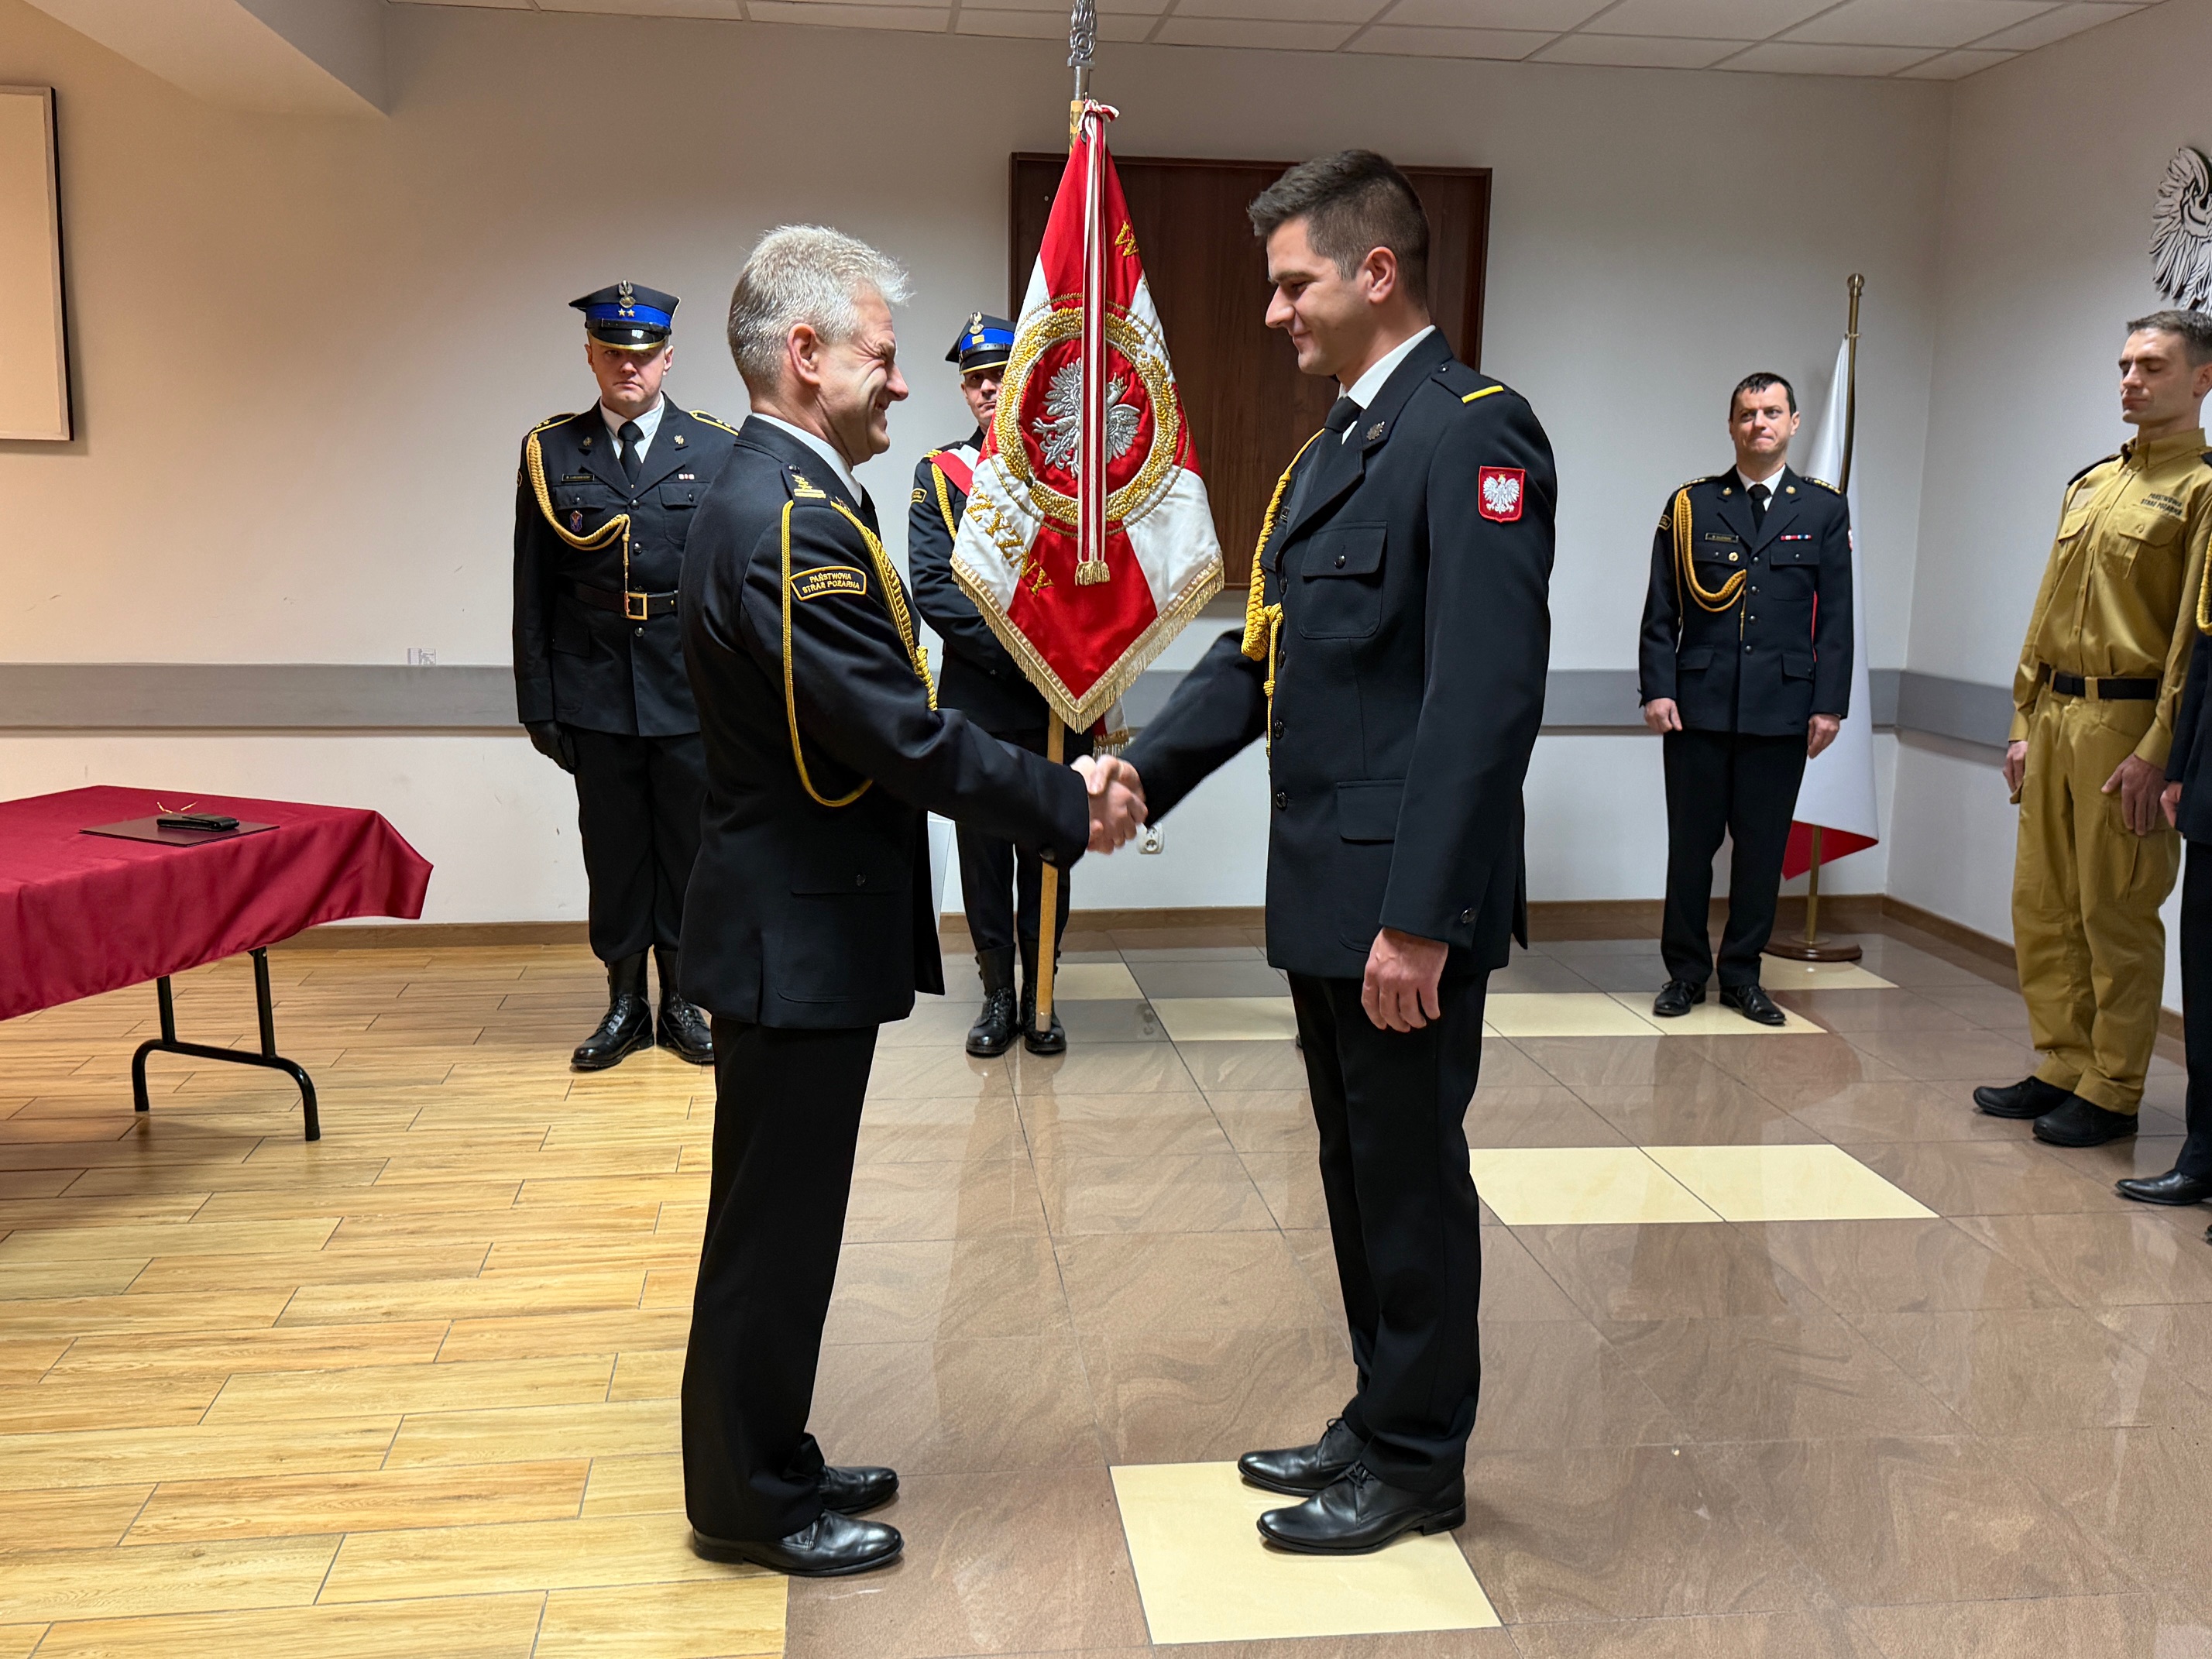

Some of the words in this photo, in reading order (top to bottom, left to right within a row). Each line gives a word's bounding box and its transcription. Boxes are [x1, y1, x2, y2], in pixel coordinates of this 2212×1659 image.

[966, 484, 1054, 596] ZYZNY
[809, 572, 852, 583] PAŃSTWOWA
[802, 581, 826, 594] STRAŻ
[826, 579, 860, 590] POŻARNA
